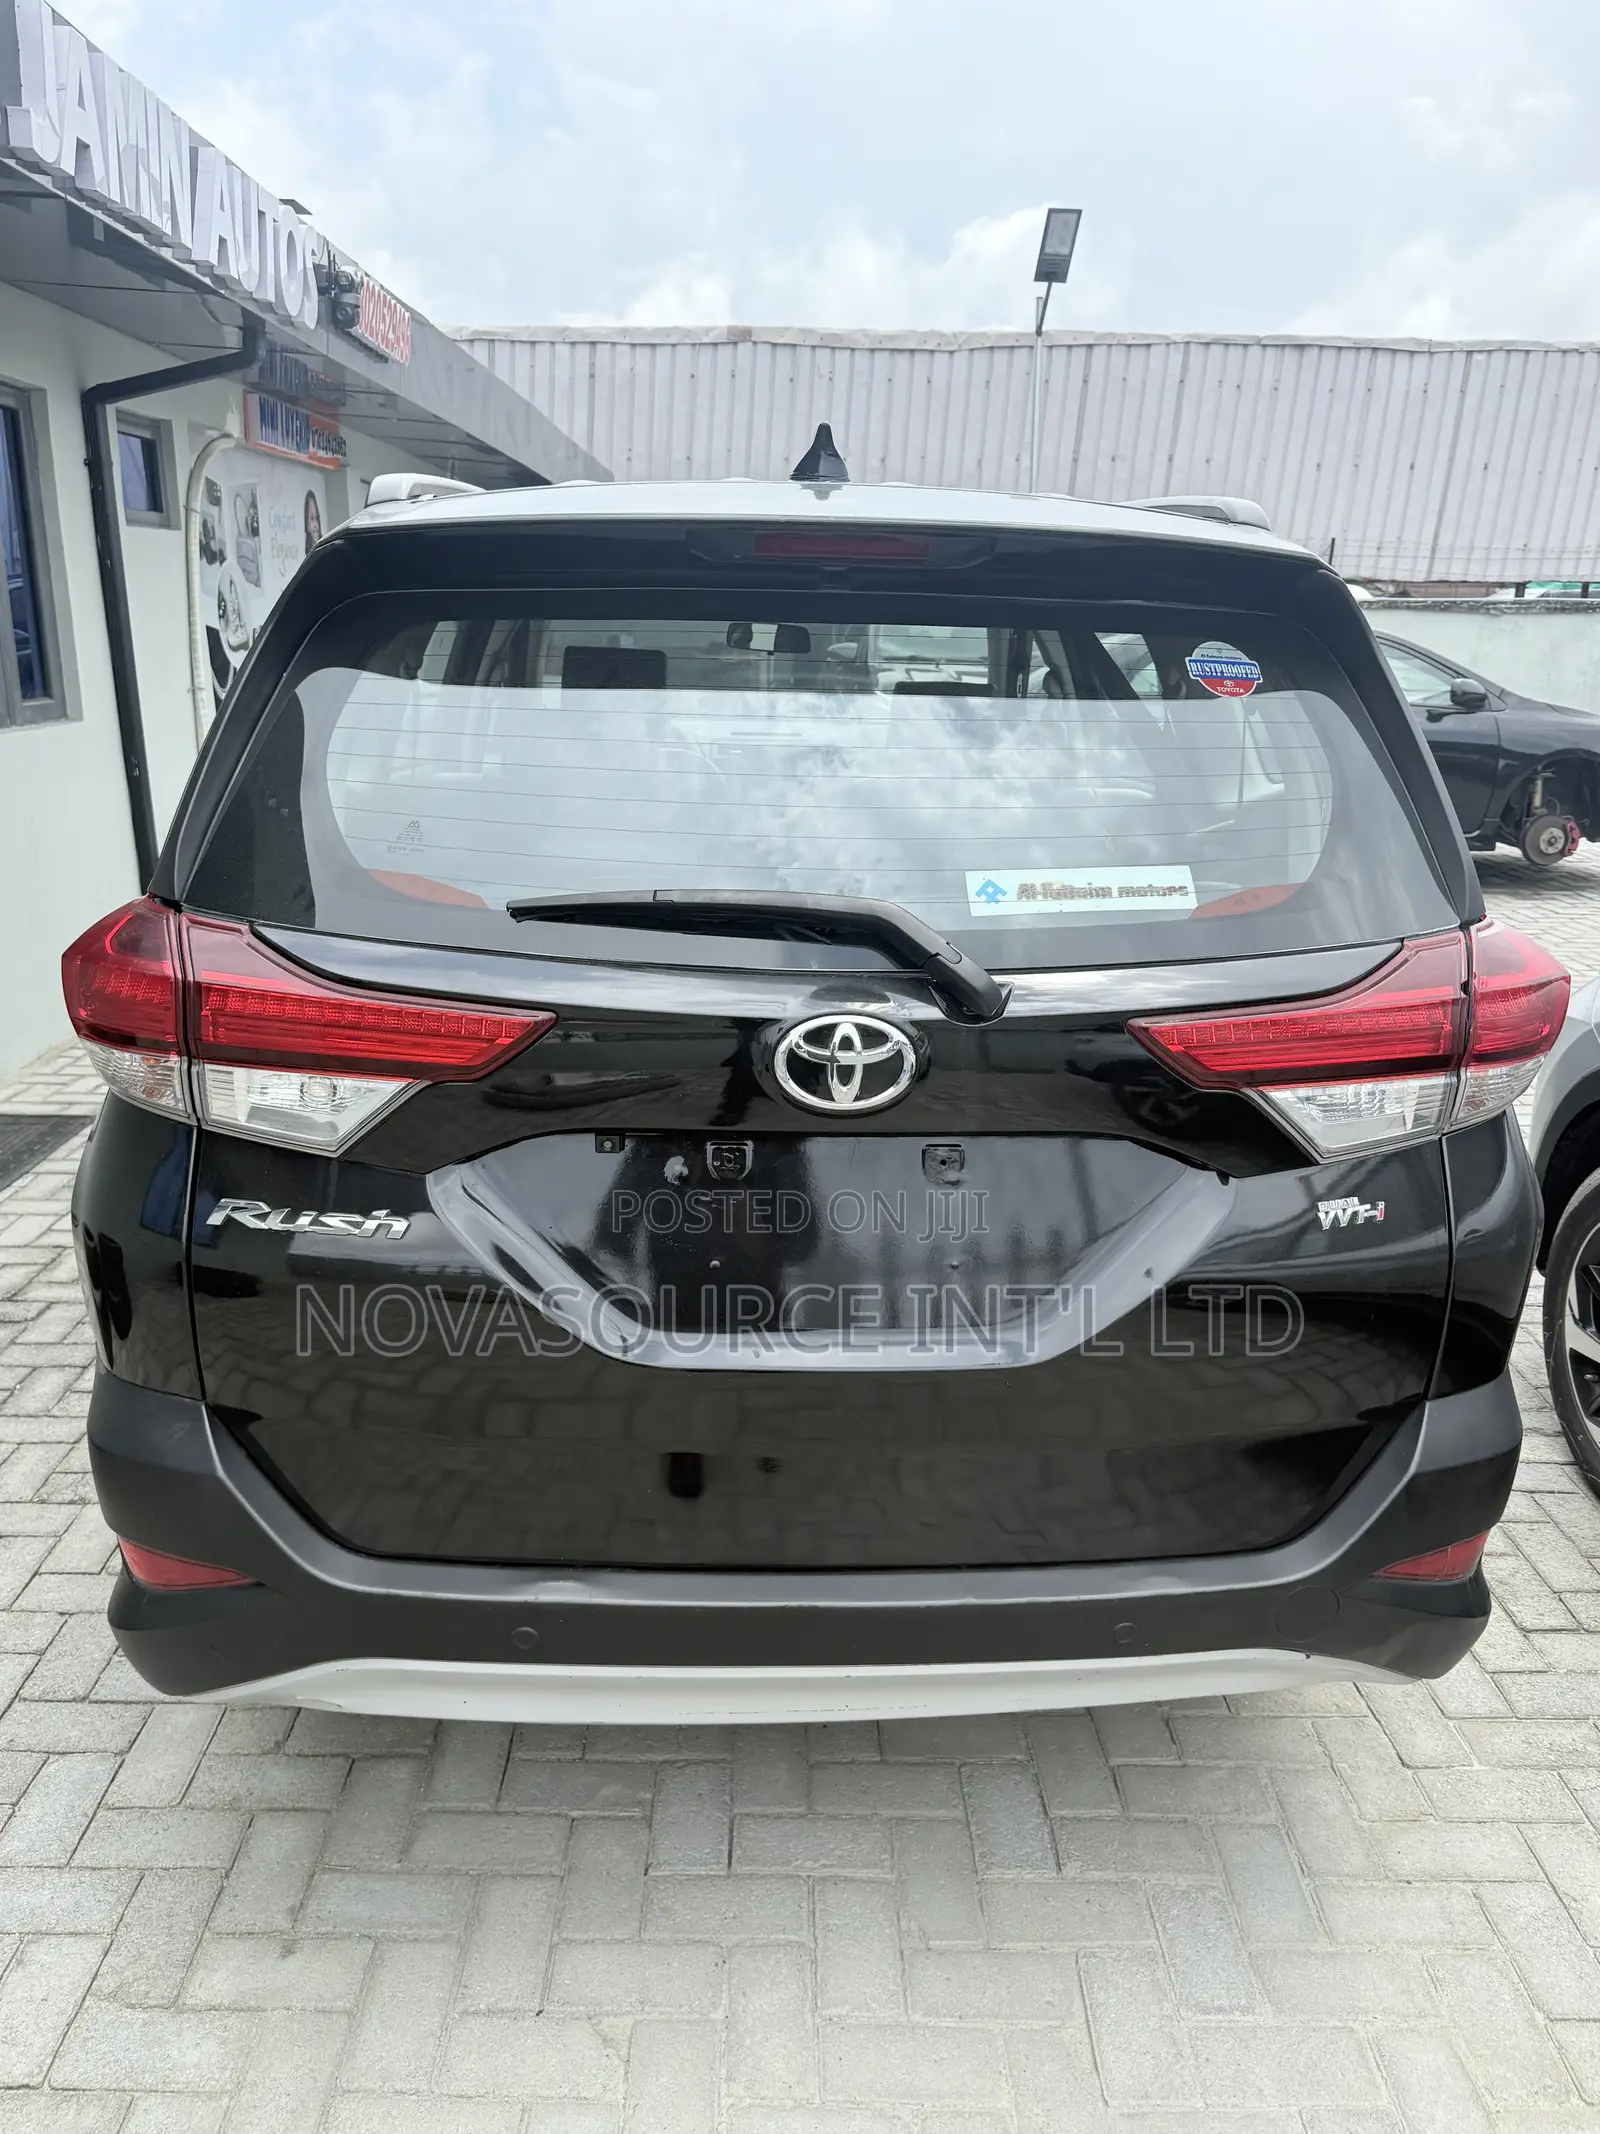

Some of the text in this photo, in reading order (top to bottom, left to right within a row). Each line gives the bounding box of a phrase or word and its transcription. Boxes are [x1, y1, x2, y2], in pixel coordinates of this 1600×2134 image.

[7, 0, 319, 330] JAMIN AUTOS
[1189, 662, 1259, 679] RUSTPROOFED
[1216, 686, 1245, 694] TOYOTA
[1117, 883, 1189, 898] motors
[1318, 1197, 1360, 1211] DUAL
[206, 1198, 411, 1239] Rush
[1316, 1201, 1385, 1230] VVT-i
